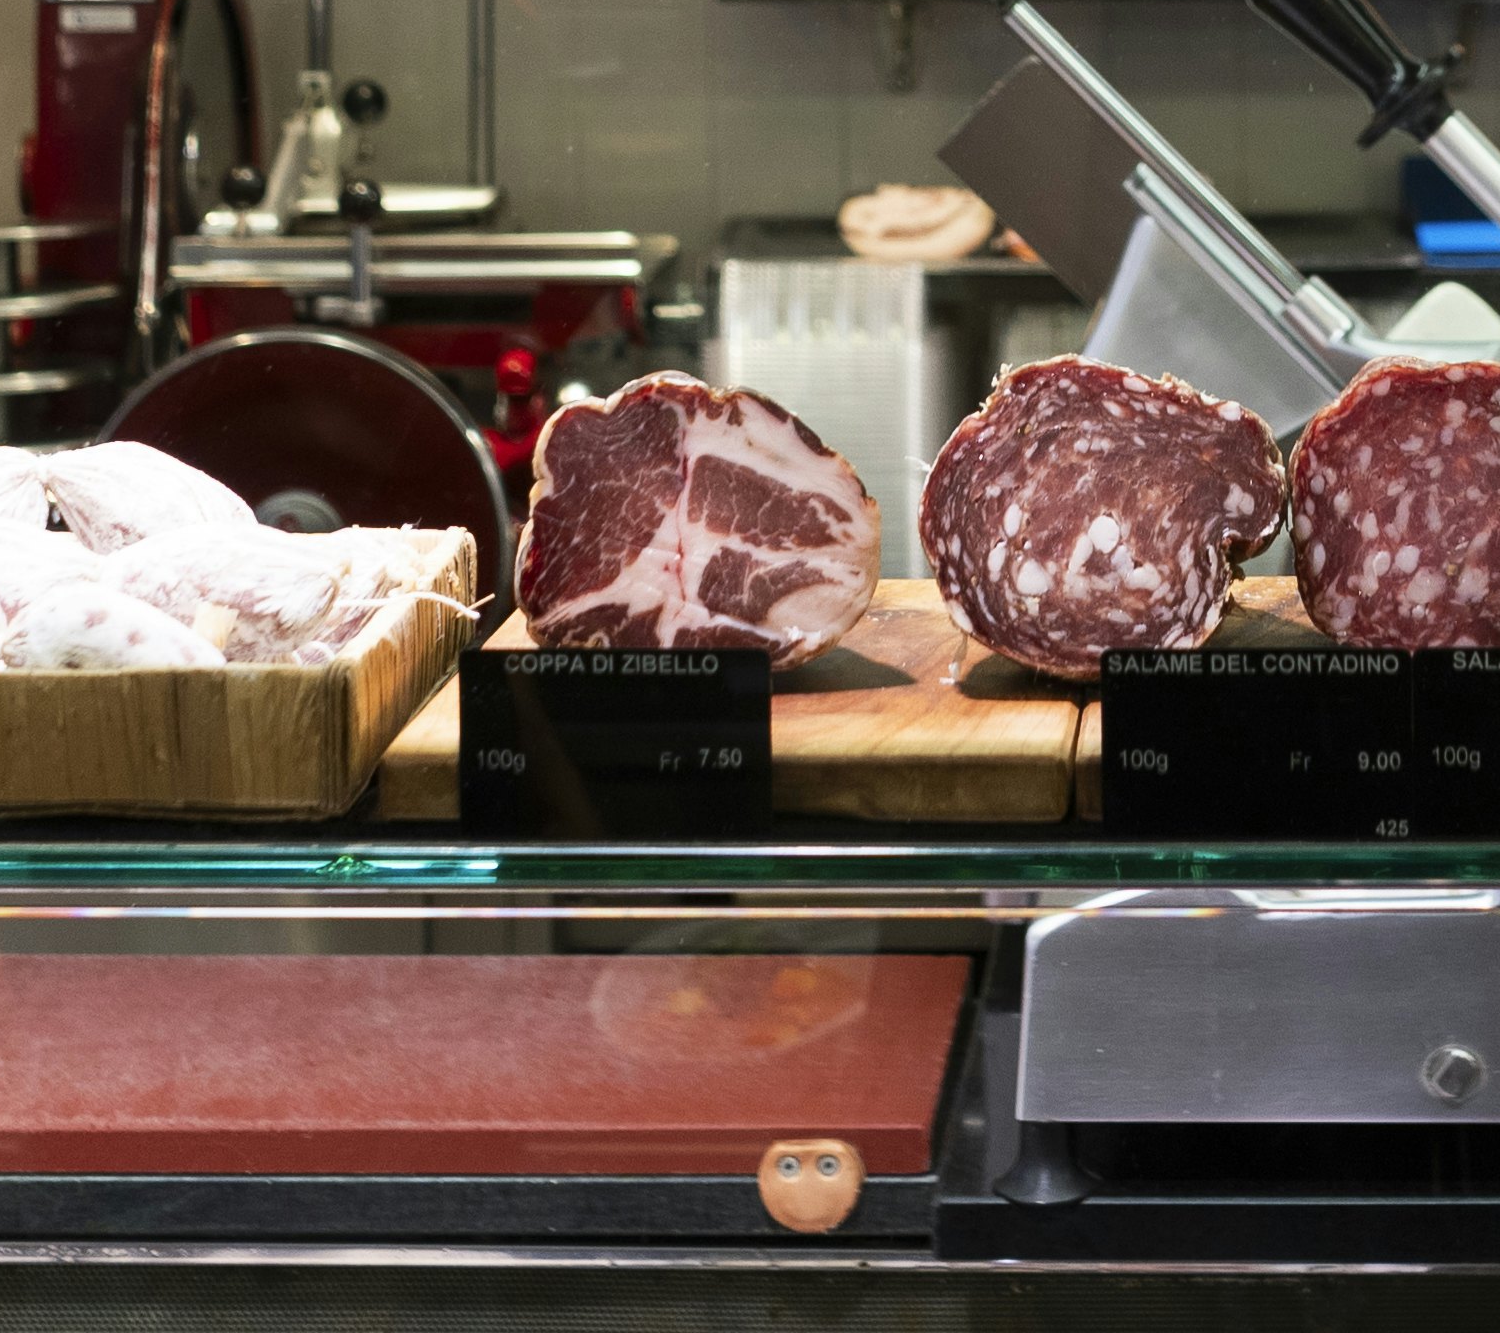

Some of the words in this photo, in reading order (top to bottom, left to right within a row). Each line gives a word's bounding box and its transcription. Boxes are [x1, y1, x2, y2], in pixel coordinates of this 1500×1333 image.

[504, 653, 586, 675] COPPA
[592, 653, 614, 674] DI
[620, 653, 719, 674] ZIBELLO
[1107, 654, 1204, 675] SALAME
[1262, 654, 1400, 675] CONTADINO
[476, 749, 526, 775] 100g
[698, 747, 743, 769] 7.50
[1119, 748, 1169, 775] 100g
[1357, 751, 1401, 773] 9.00
[1432, 746, 1481, 773] 100g
[1375, 819, 1409, 837] 425
